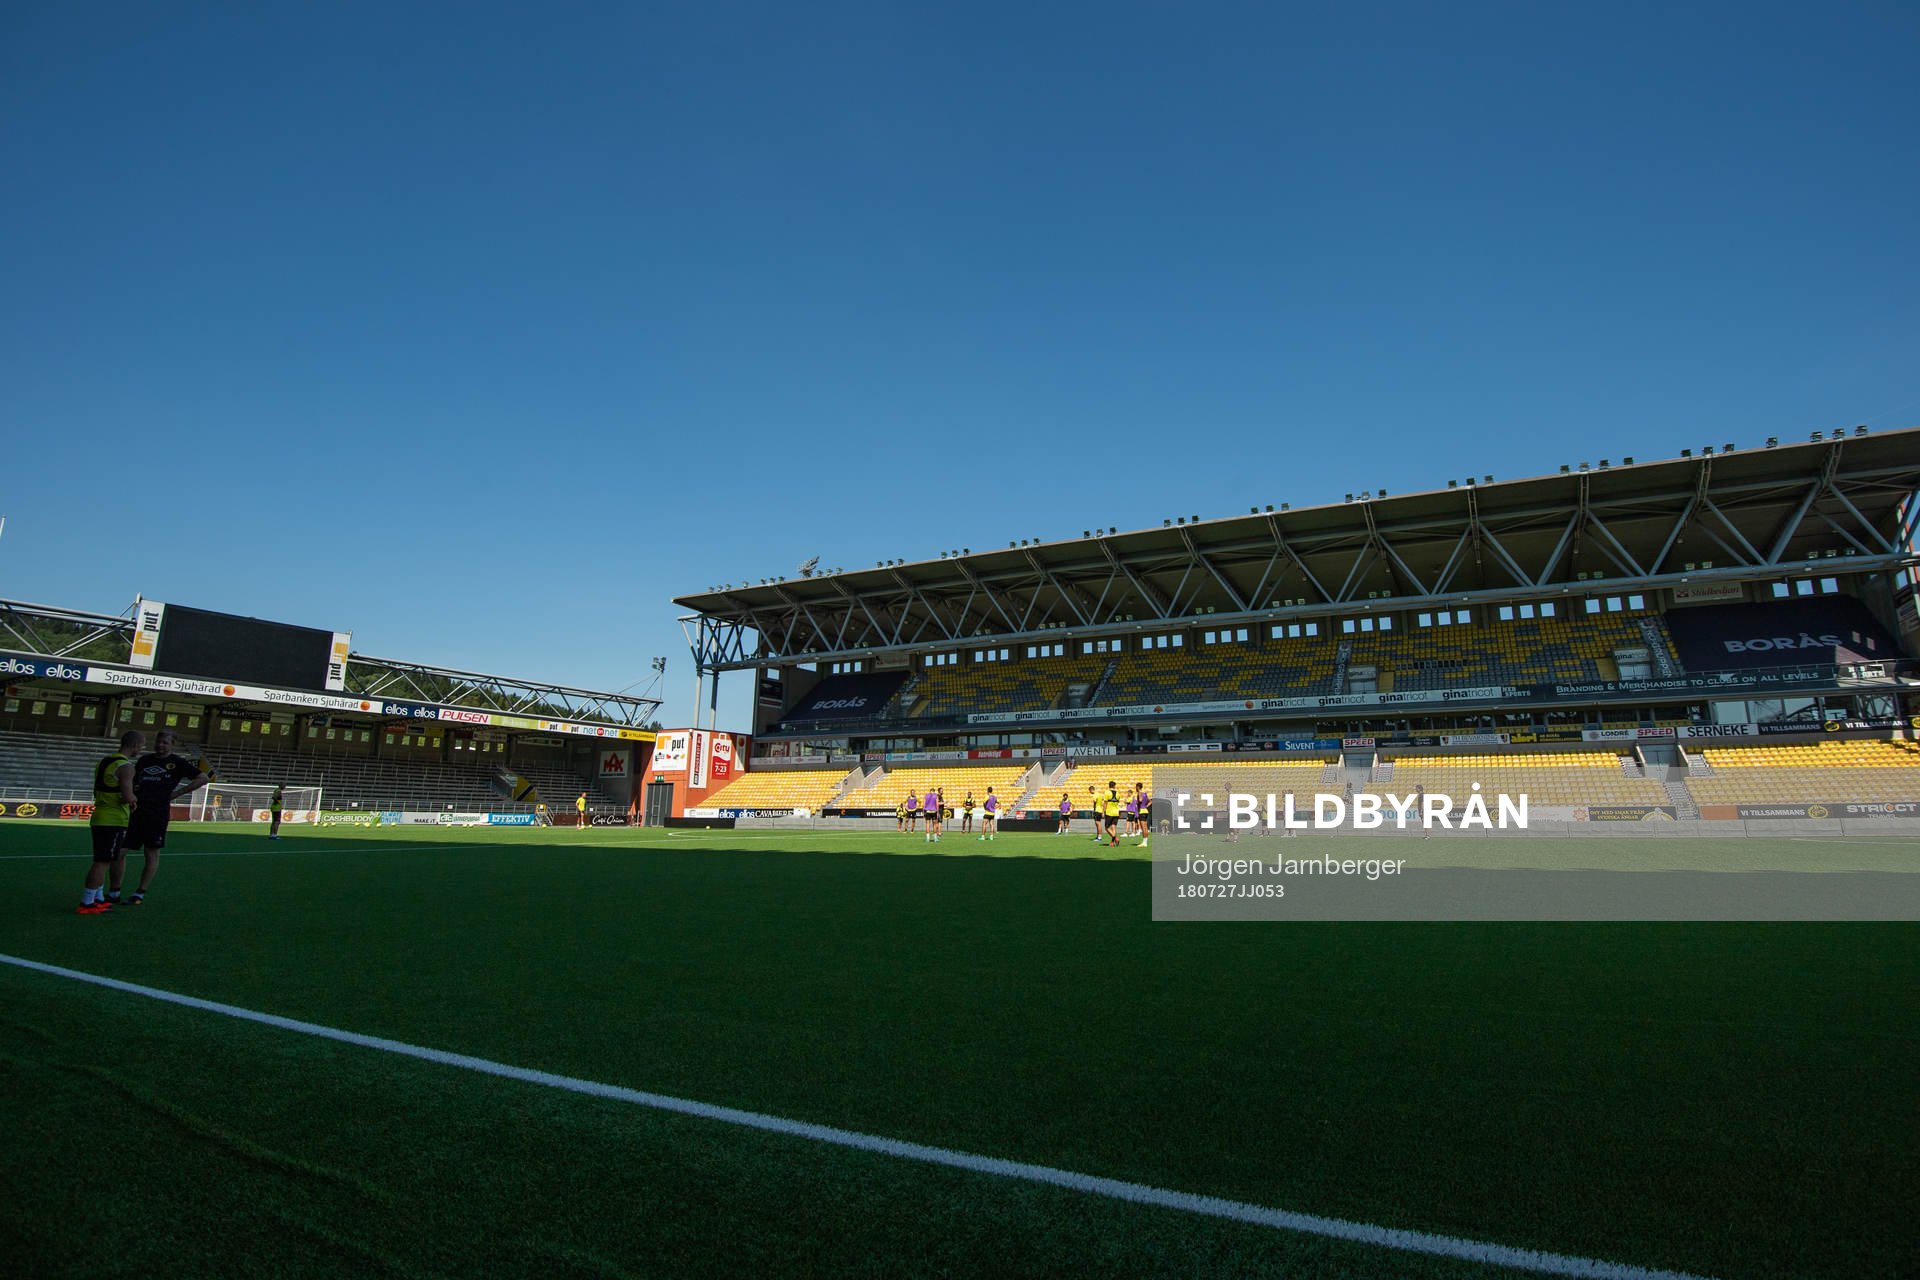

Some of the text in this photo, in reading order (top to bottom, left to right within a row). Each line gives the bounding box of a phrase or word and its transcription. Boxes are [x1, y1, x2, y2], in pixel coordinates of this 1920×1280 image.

[1724, 633, 1842, 653] BORÅS
[0, 659, 35, 674] ellos
[46, 664, 80, 679] ellos
[106, 672, 221, 694] Sparbanken Sjuhärad
[1556, 685, 1603, 694] BRANDING
[1608, 683, 1615, 691] &
[1619, 680, 1687, 689] MERCHANDISE
[1782, 672, 1818, 680] LEVELS
[264, 690, 358, 708] Sparbanken Sjuhärad
[1318, 694, 1366, 706] ginatricot
[1379, 692, 1427, 703] ginatricot
[1442, 688, 1494, 700] ginatricot
[1262, 698, 1306, 708] ginatricot
[386, 704, 408, 716] ellos
[414, 707, 436, 718] ellos
[1106, 707, 1144, 716] ginatricot
[442, 710, 488, 723] PULSEN
[1637, 728, 1672, 736] SPEED
[1688, 724, 1749, 738] SERNEKE
[1074, 746, 1110, 756] AVENTI
[1285, 740, 1315, 750] SILVENT
[604, 752, 624, 772] MAX
[324, 814, 373, 822] CASHBUDDY
[492, 814, 530, 822] EFFEKTIV
